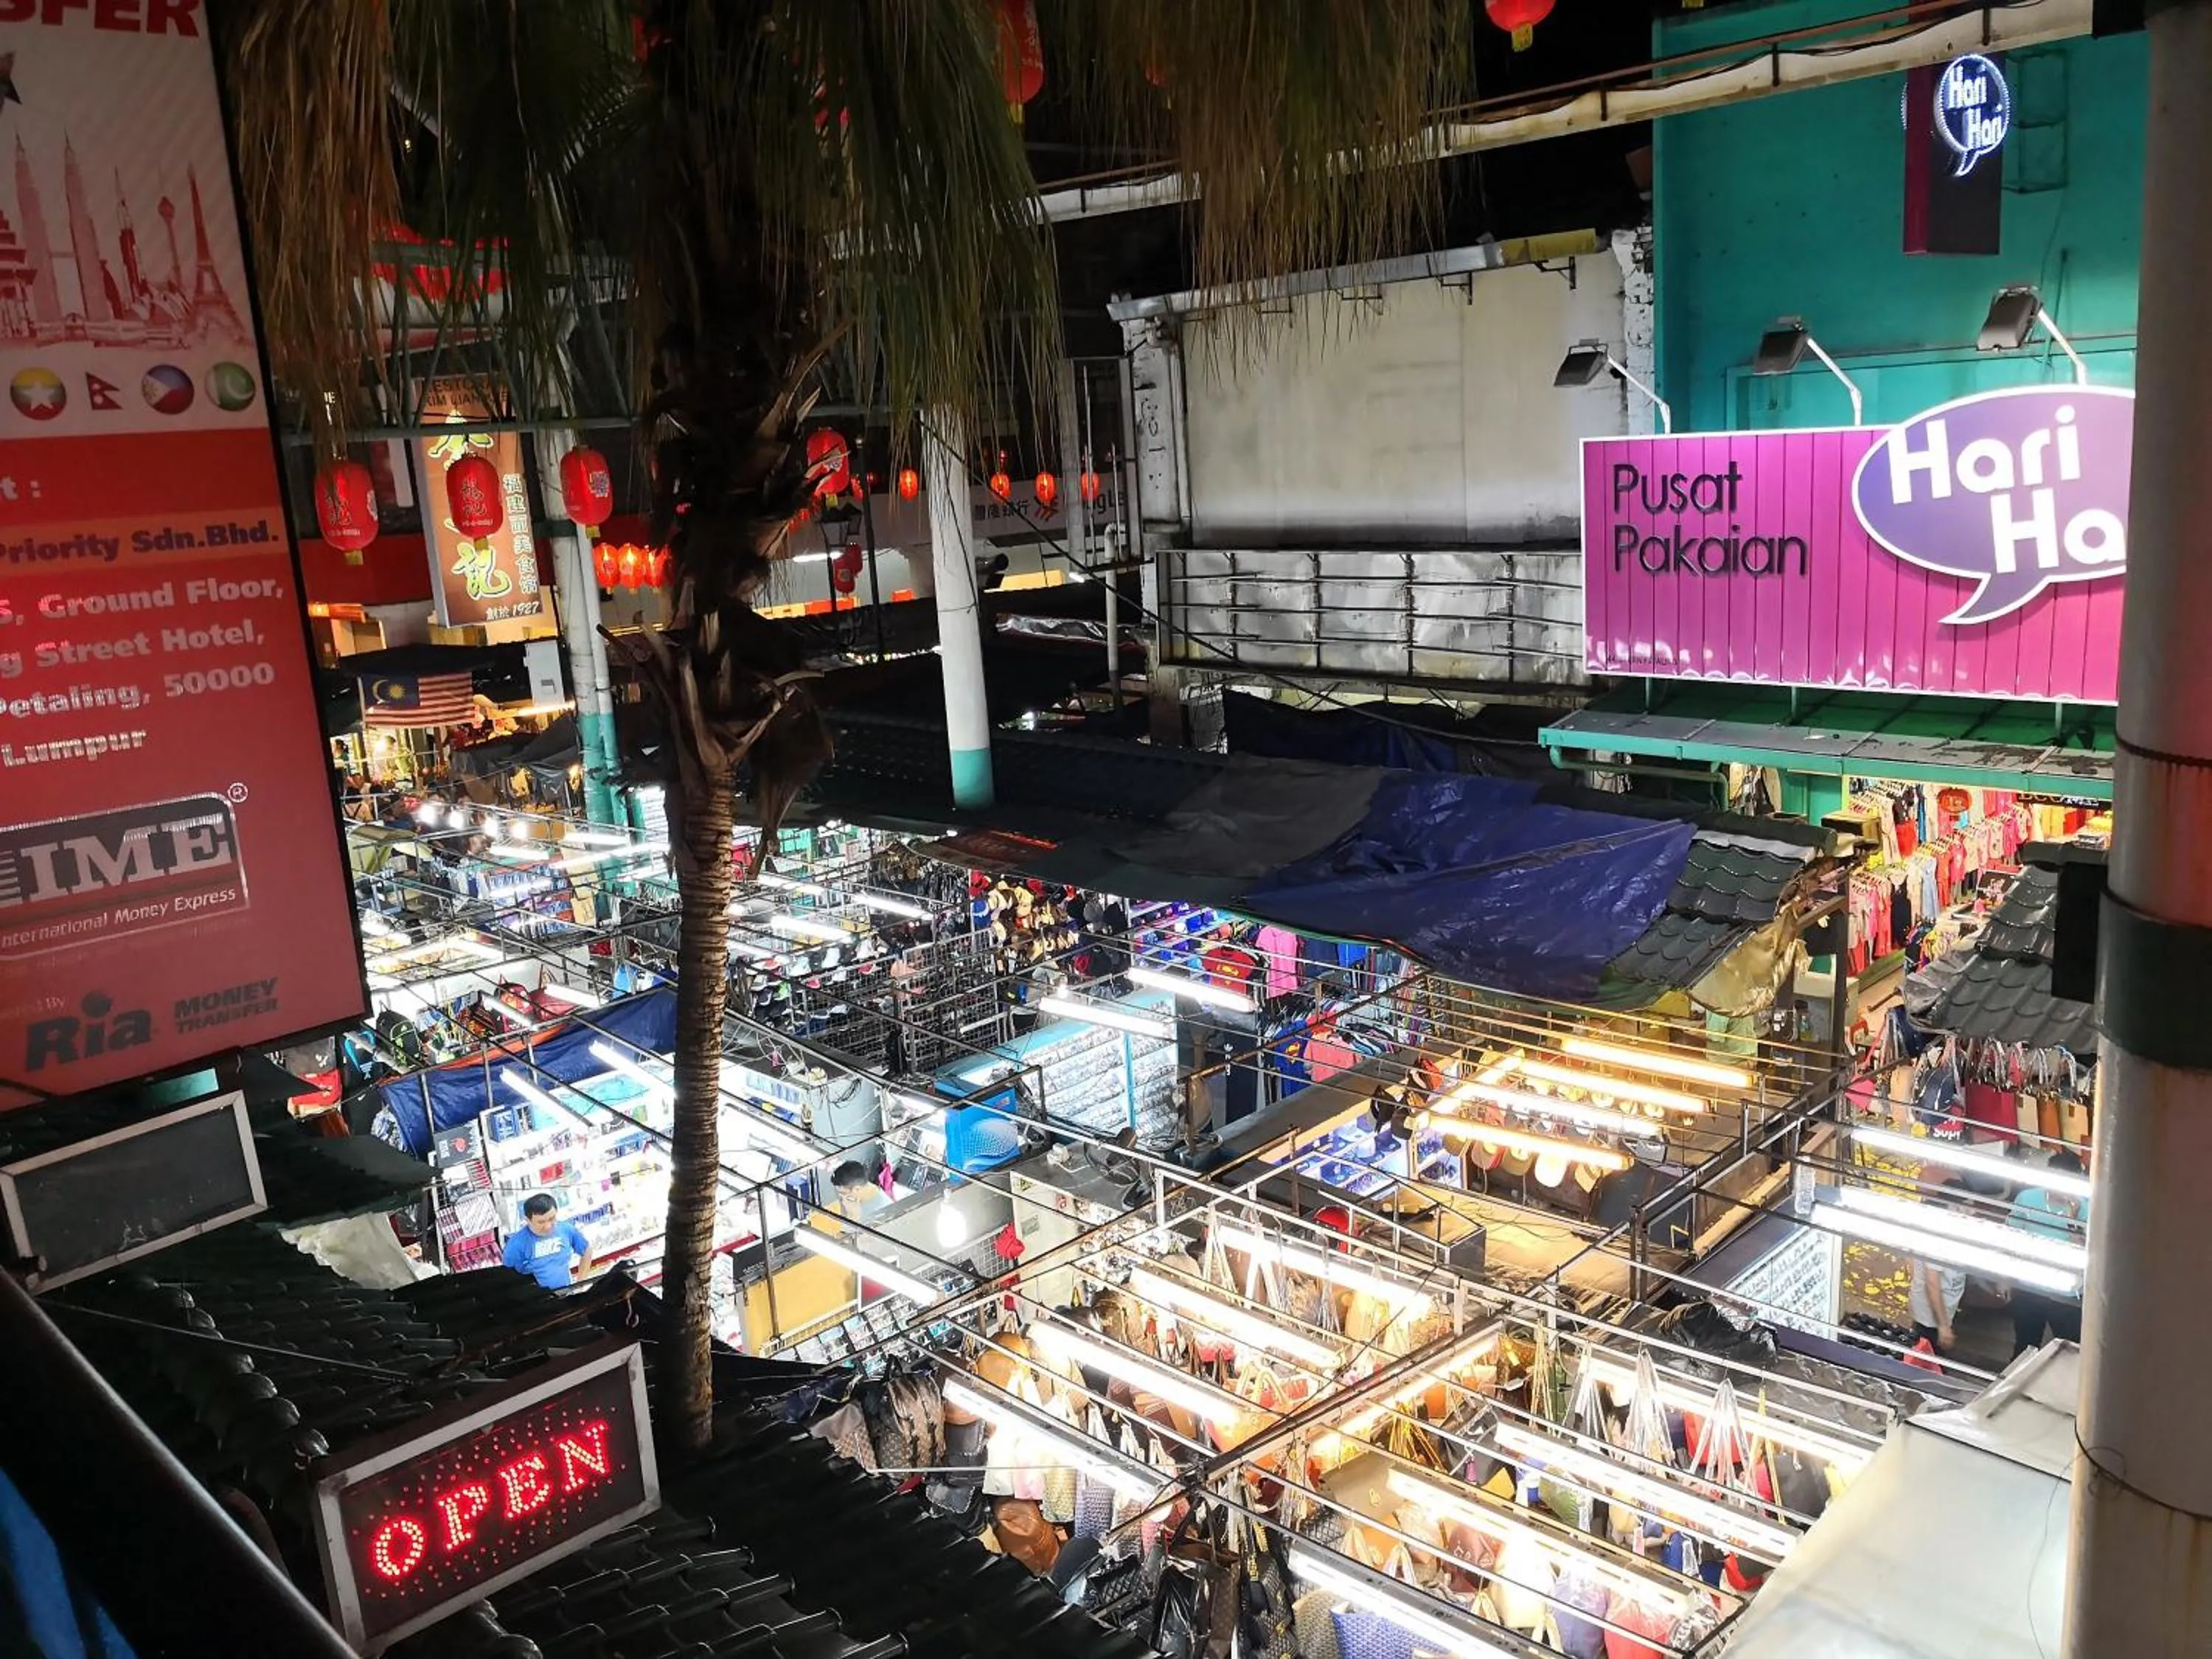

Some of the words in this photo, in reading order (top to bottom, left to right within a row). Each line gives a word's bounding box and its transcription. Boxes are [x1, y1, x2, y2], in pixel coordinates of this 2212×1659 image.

[1948, 63, 1988, 109] Hari
[1967, 103, 2003, 148] Hari
[1887, 404, 2081, 504] Hari
[0, 476, 18, 501] t
[1613, 461, 1743, 515] Pusat
[131, 520, 279, 553] Sdn.Bhd.
[1613, 524, 1808, 577] Pakaian
[1989, 487, 2126, 574] Ha
[38, 582, 175, 619] Ground
[186, 577, 284, 605] Floor,
[512, 601, 540, 616] 1927
[0, 651, 22, 677] g
[36, 632, 152, 668] Street
[161, 619, 265, 653] Hotel,
[164, 662, 274, 698] 50000
[1, 728, 147, 768] Lumpur
[20, 813, 232, 902] IME
[1, 911, 108, 949] nternational
[114, 900, 169, 925] Money
[174, 886, 237, 913] Express
[175, 977, 279, 1019] MONEY
[176, 998, 279, 1034] TRANSFER
[25, 990, 153, 1074] Ria
[375, 1422, 607, 1577] OPEN
